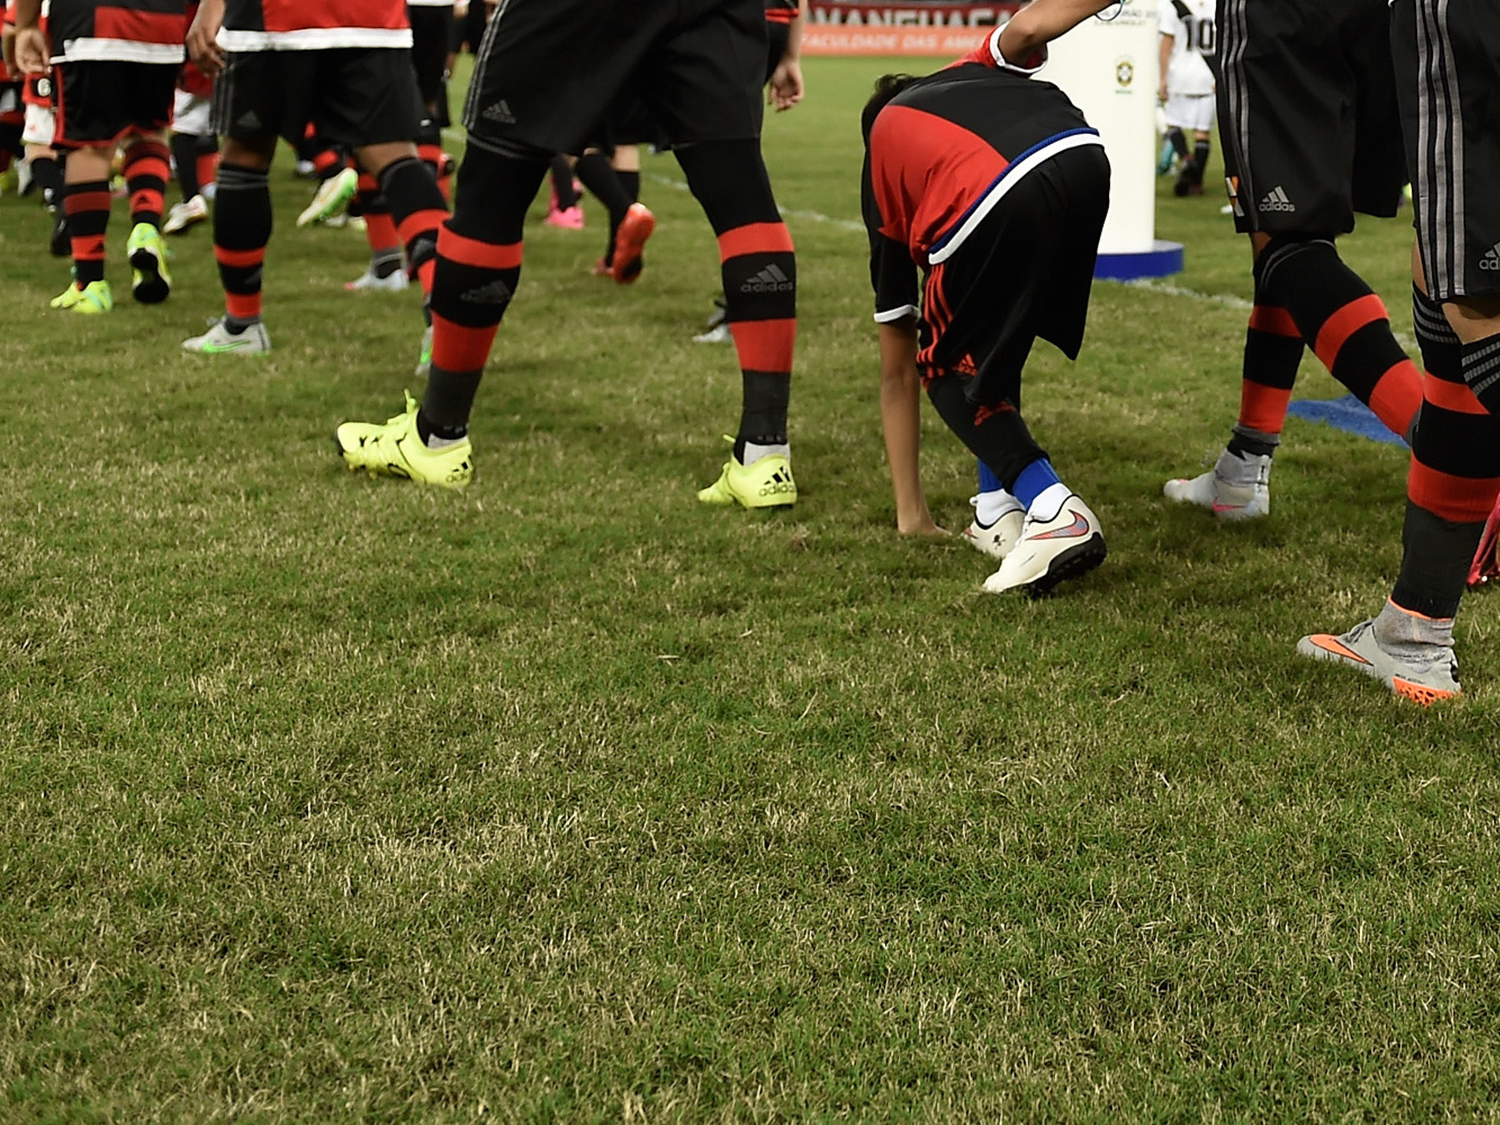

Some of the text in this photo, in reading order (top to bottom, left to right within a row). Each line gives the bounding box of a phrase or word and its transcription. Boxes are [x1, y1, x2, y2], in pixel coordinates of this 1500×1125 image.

[1182, 17, 1214, 54] 10
[1259, 201, 1295, 212] adidas
[741, 281, 793, 293] adidas
